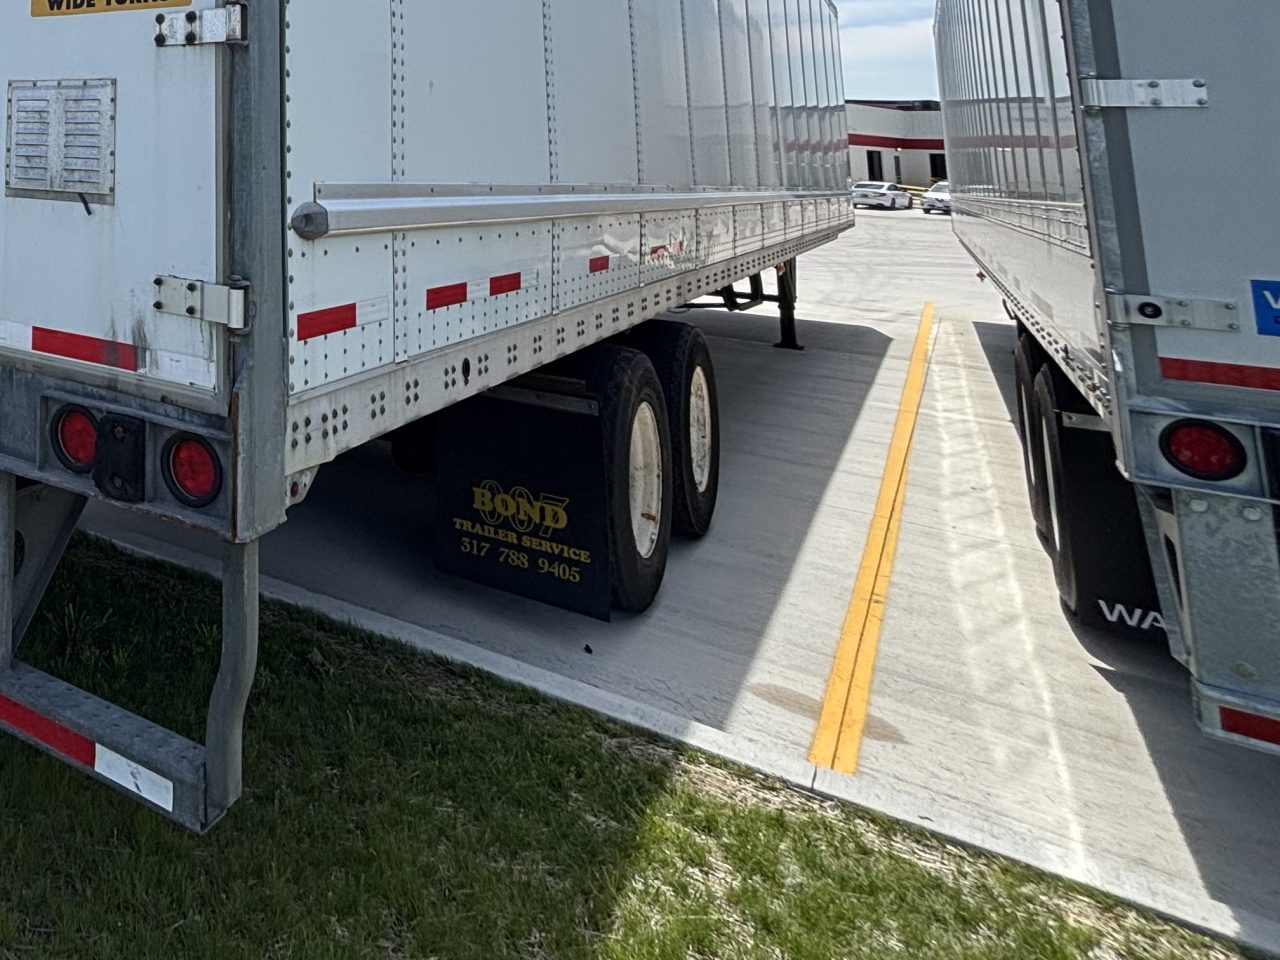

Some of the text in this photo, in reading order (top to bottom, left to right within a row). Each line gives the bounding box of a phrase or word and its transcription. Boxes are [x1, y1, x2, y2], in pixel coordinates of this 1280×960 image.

[472, 486, 568, 529] BOND
[452, 517, 592, 564] TRAILER SERVICE
[460, 537, 581, 583] 317 788 9405
